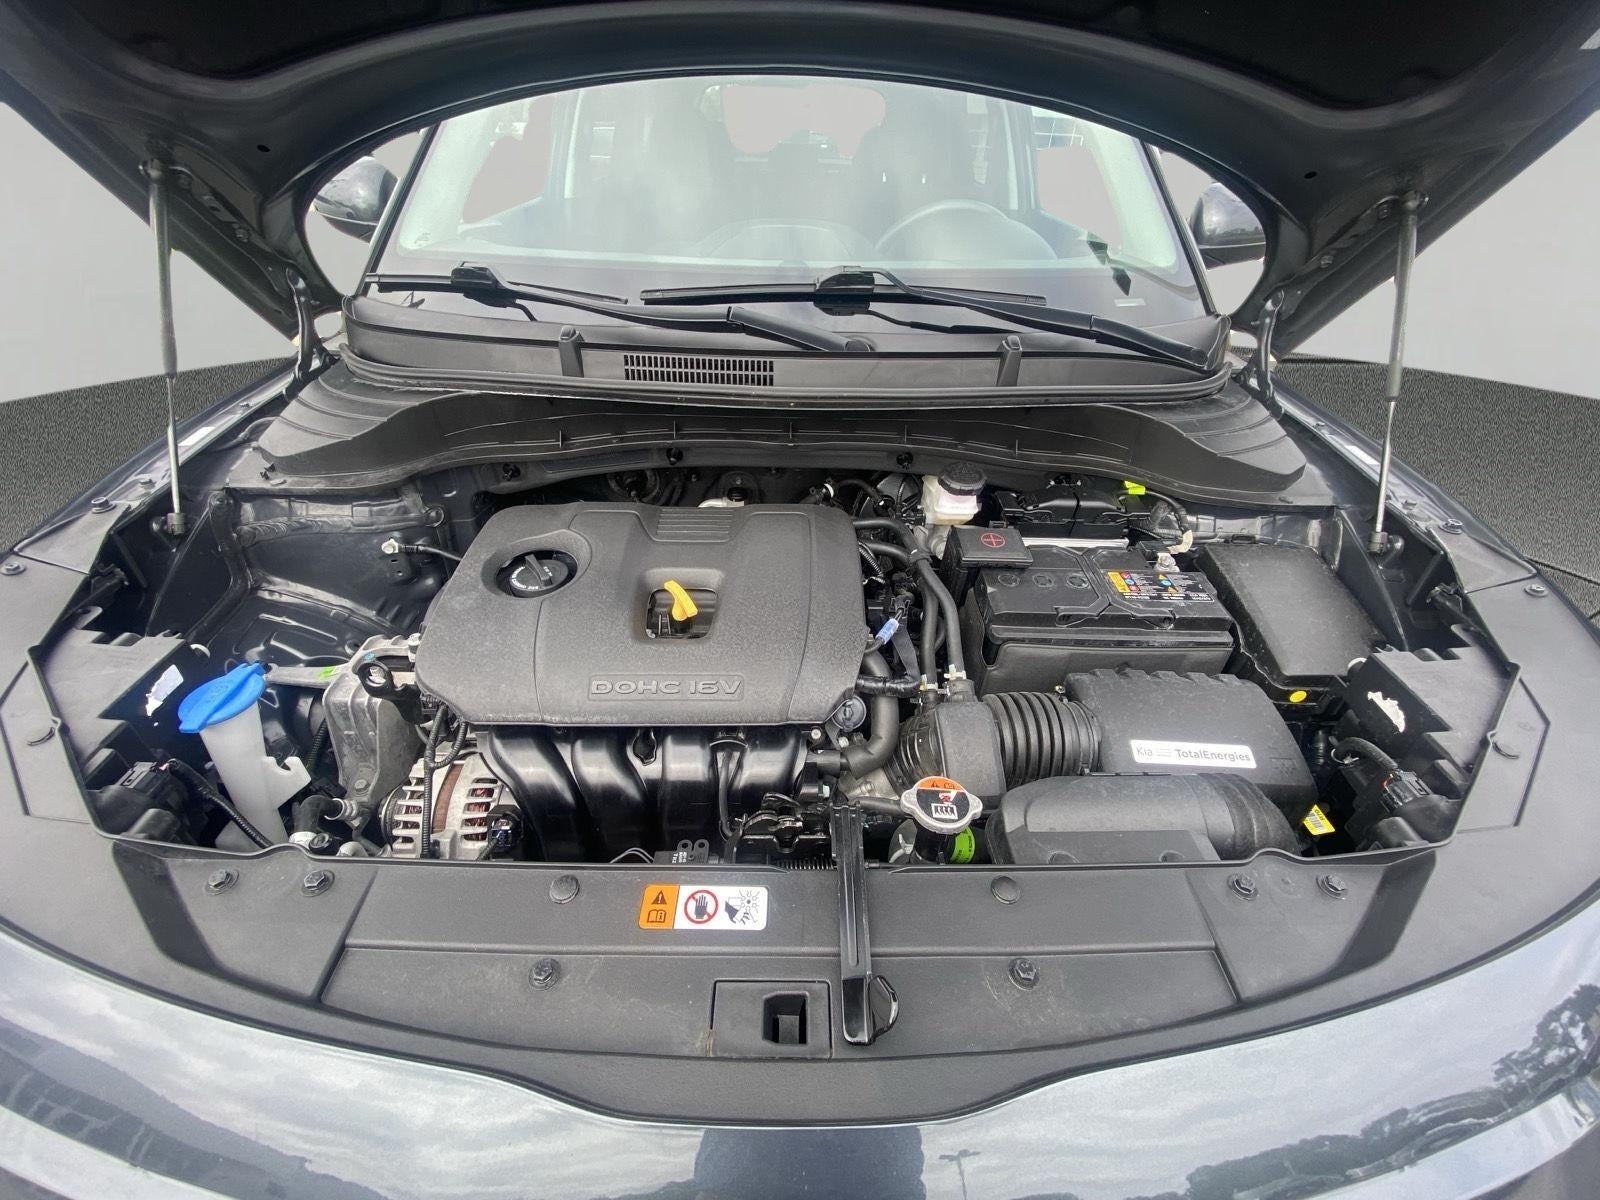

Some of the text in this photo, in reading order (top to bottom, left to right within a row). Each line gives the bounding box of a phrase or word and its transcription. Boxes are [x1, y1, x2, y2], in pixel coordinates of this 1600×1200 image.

[591, 680, 741, 695] DOHC 16V
[1136, 746, 1153, 757] Kia
[1174, 748, 1251, 762] TotalEnergies
